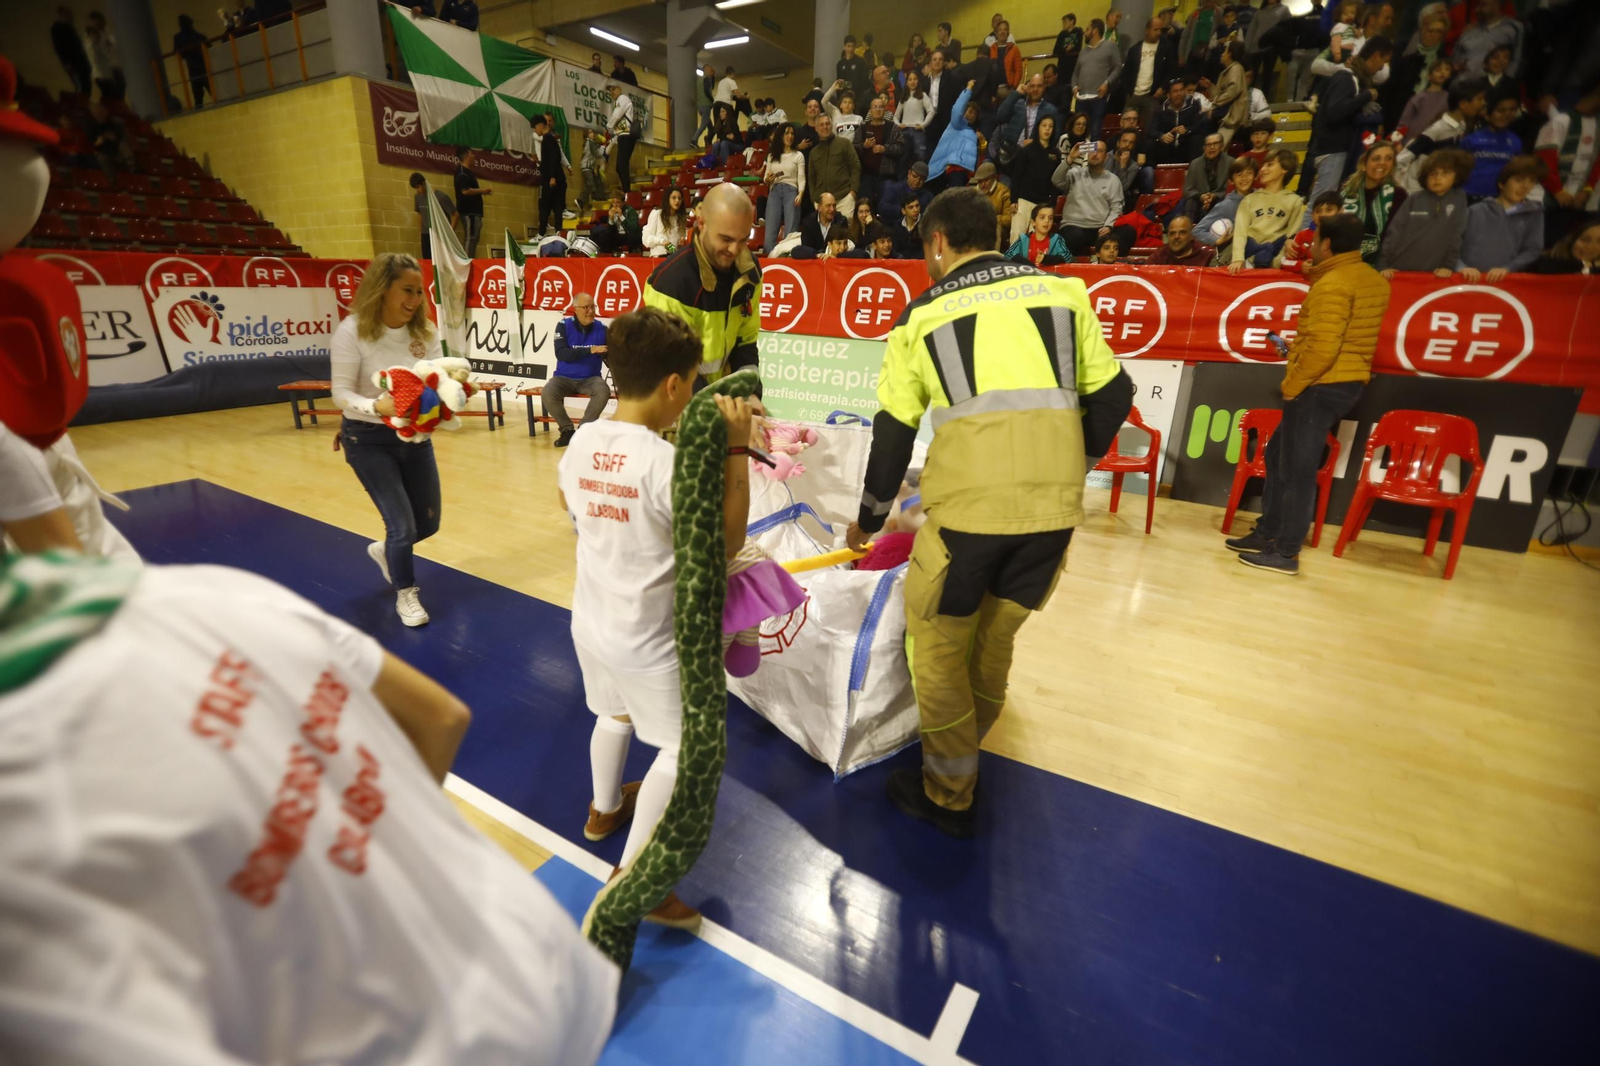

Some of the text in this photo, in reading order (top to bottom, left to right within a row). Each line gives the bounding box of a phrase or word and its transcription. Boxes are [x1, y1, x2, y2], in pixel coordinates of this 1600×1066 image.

[565, 69, 580, 80] LOS
[573, 82, 613, 104] LOCOS
[584, 99, 600, 110] DEL
[574, 106, 608, 128] FUTS
[836, 124, 856, 133] FILA
[385, 142, 425, 158] Instituto
[426, 149, 461, 164] Municip
[480, 158, 514, 172] Deportes
[1254, 206, 1287, 218] ESP
[161, 273, 198, 285] RF
[255, 268, 286, 280] RF
[487, 279, 506, 291] RF
[542, 280, 563, 293] RF
[606, 280, 630, 294] RF
[762, 283, 794, 299] RF
[540, 297, 565, 308] EF
[858, 286, 896, 303] RF
[943, 283, 1052, 313] CÓRDOBA
[604, 298, 629, 311] EF
[759, 302, 793, 318] EF
[1095, 297, 1147, 316] RF
[1249, 304, 1302, 321] RF
[854, 309, 893, 325] EF
[1430, 311, 1503, 334] RF
[227, 314, 332, 346] pidetaxi
[234, 334, 289, 347] Córdoba
[757, 333, 850, 360] vázquez
[1422, 338, 1500, 363] EF
[472, 362, 531, 375] new man
